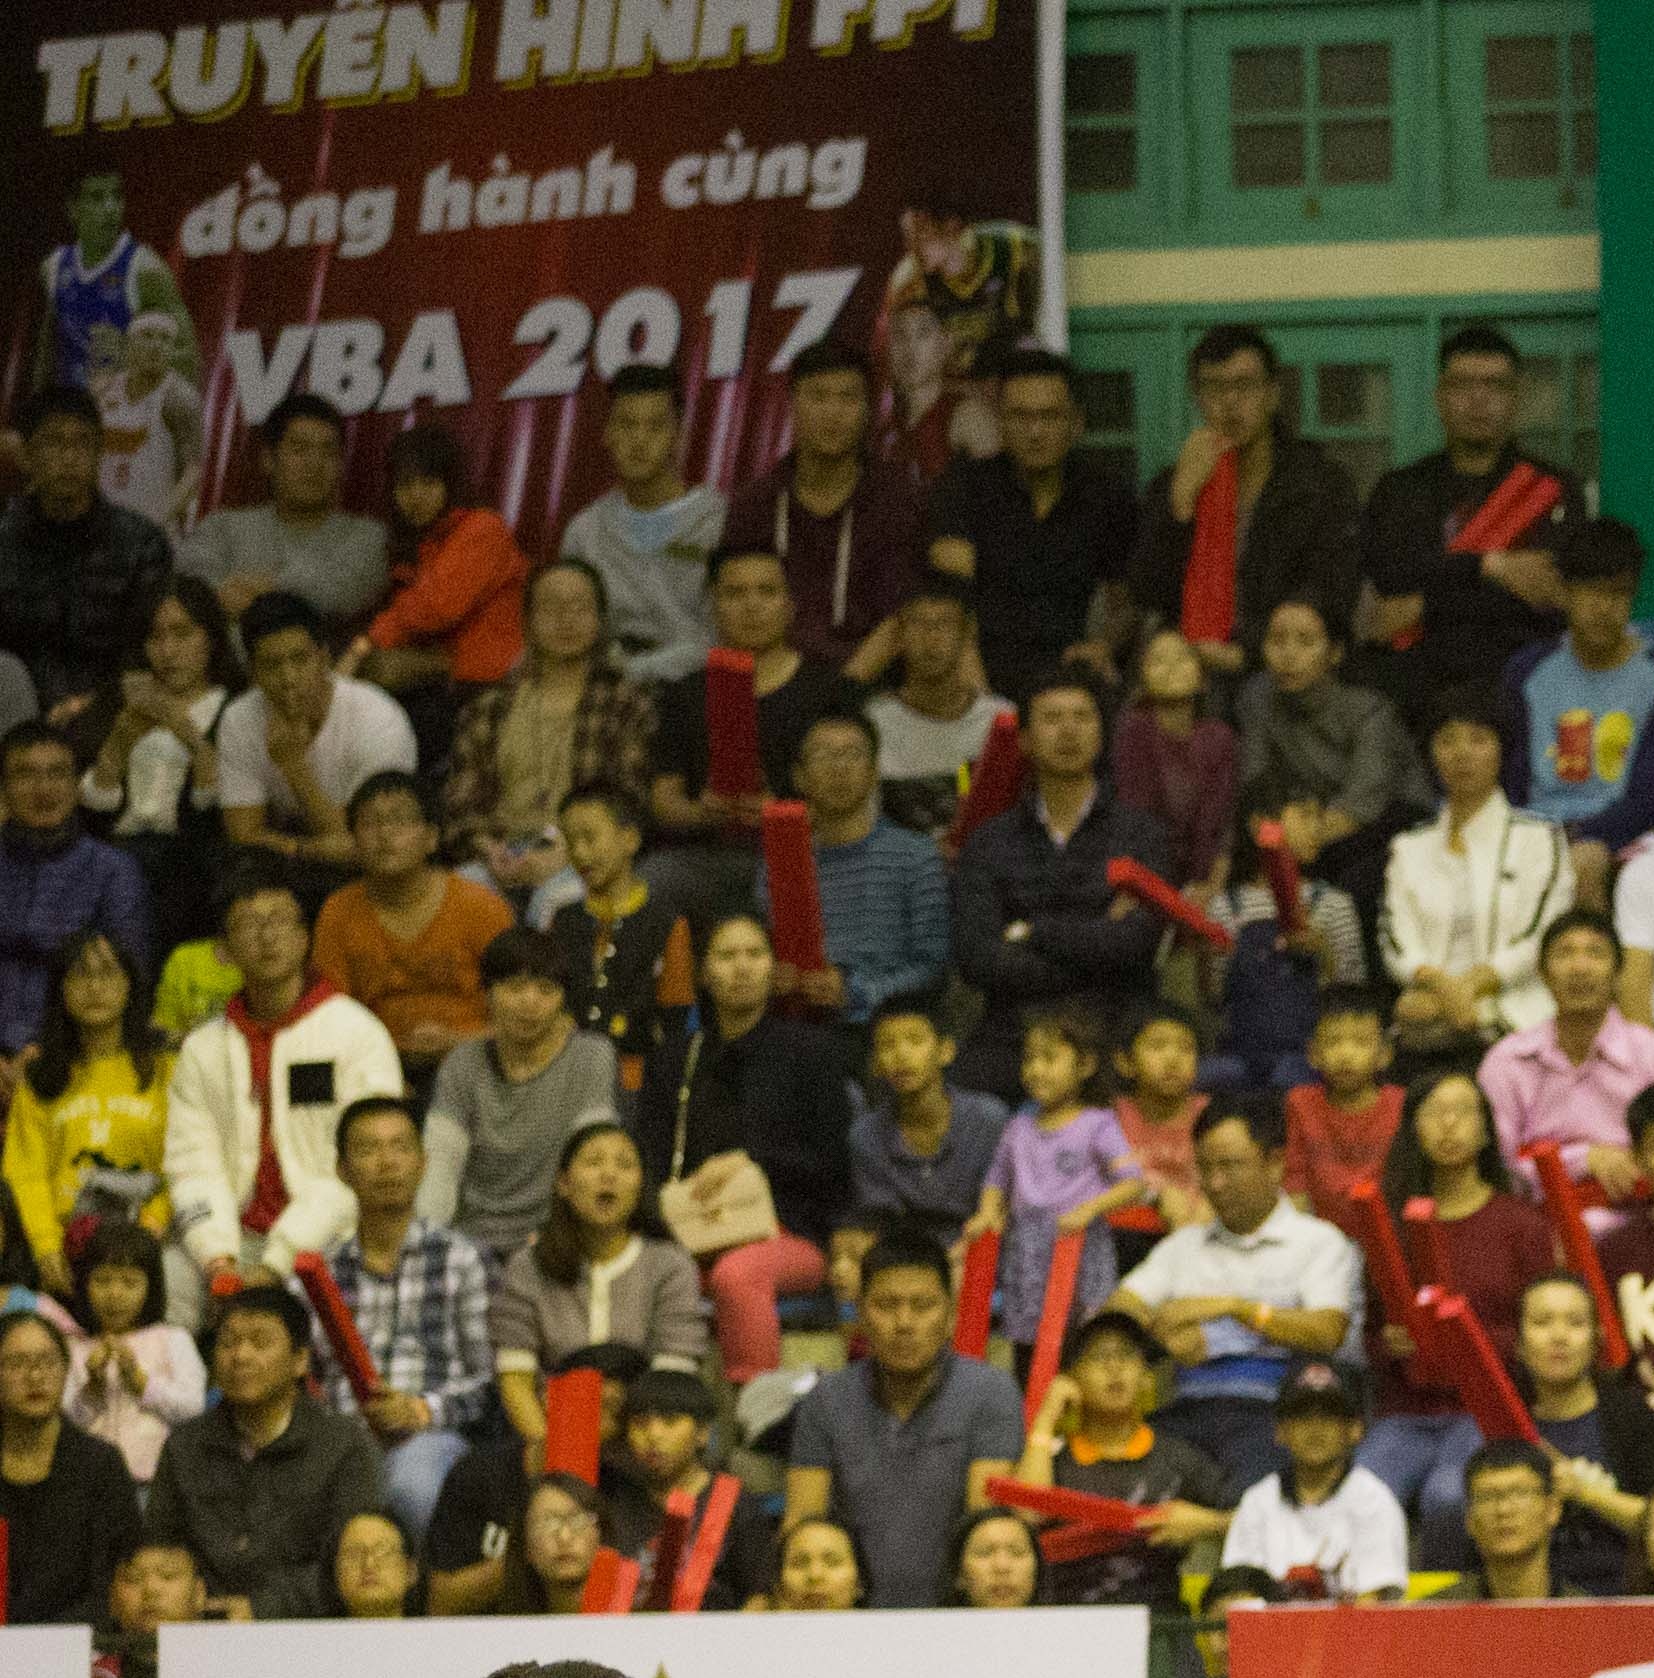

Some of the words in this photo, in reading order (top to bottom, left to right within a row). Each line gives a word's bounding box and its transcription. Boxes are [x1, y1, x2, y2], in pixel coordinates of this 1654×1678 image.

[180, 162, 398, 259] đồng
[419, 145, 638, 234] hành
[222, 308, 473, 427] VBA
[500, 268, 862, 402] 2017
